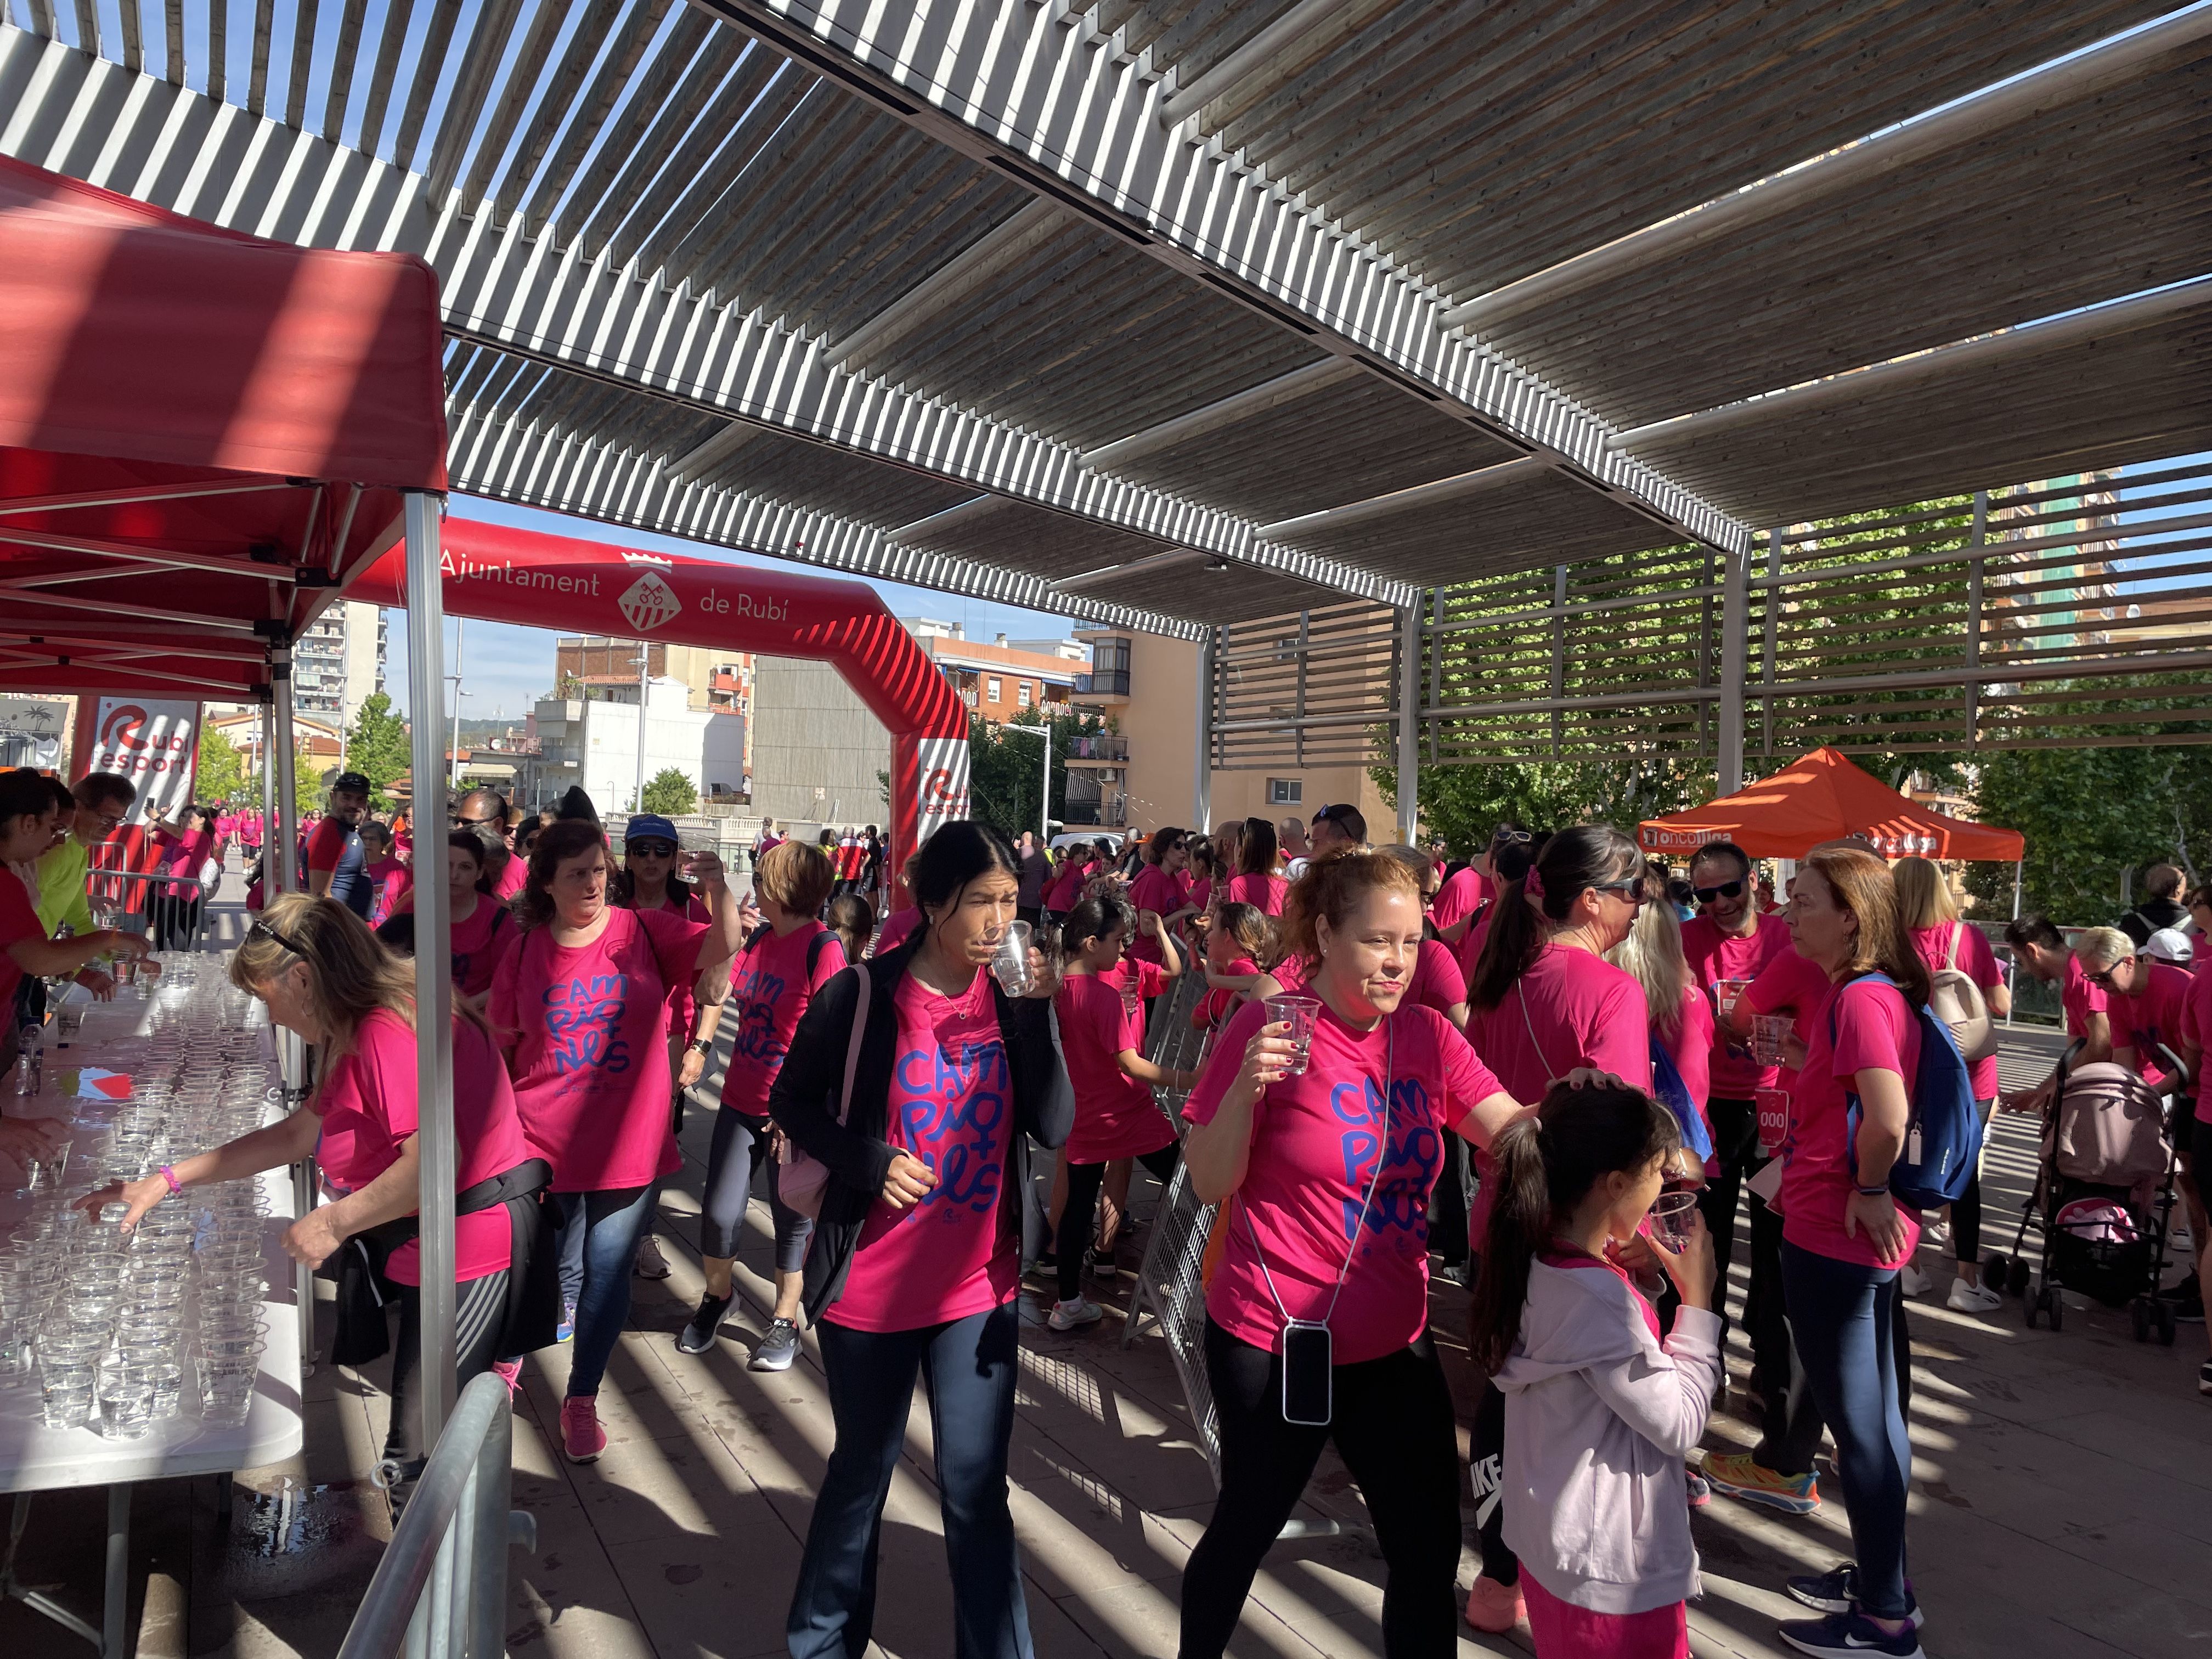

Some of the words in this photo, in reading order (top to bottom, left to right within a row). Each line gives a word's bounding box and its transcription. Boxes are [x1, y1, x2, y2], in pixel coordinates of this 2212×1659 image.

[440, 549, 600, 596] Ajuntament
[700, 588, 730, 613] de
[737, 593, 789, 621] Rubí
[100, 753, 186, 775] esport
[1760, 1111, 1784, 1128] 000
[1470, 1453, 1502, 1499] IKE
